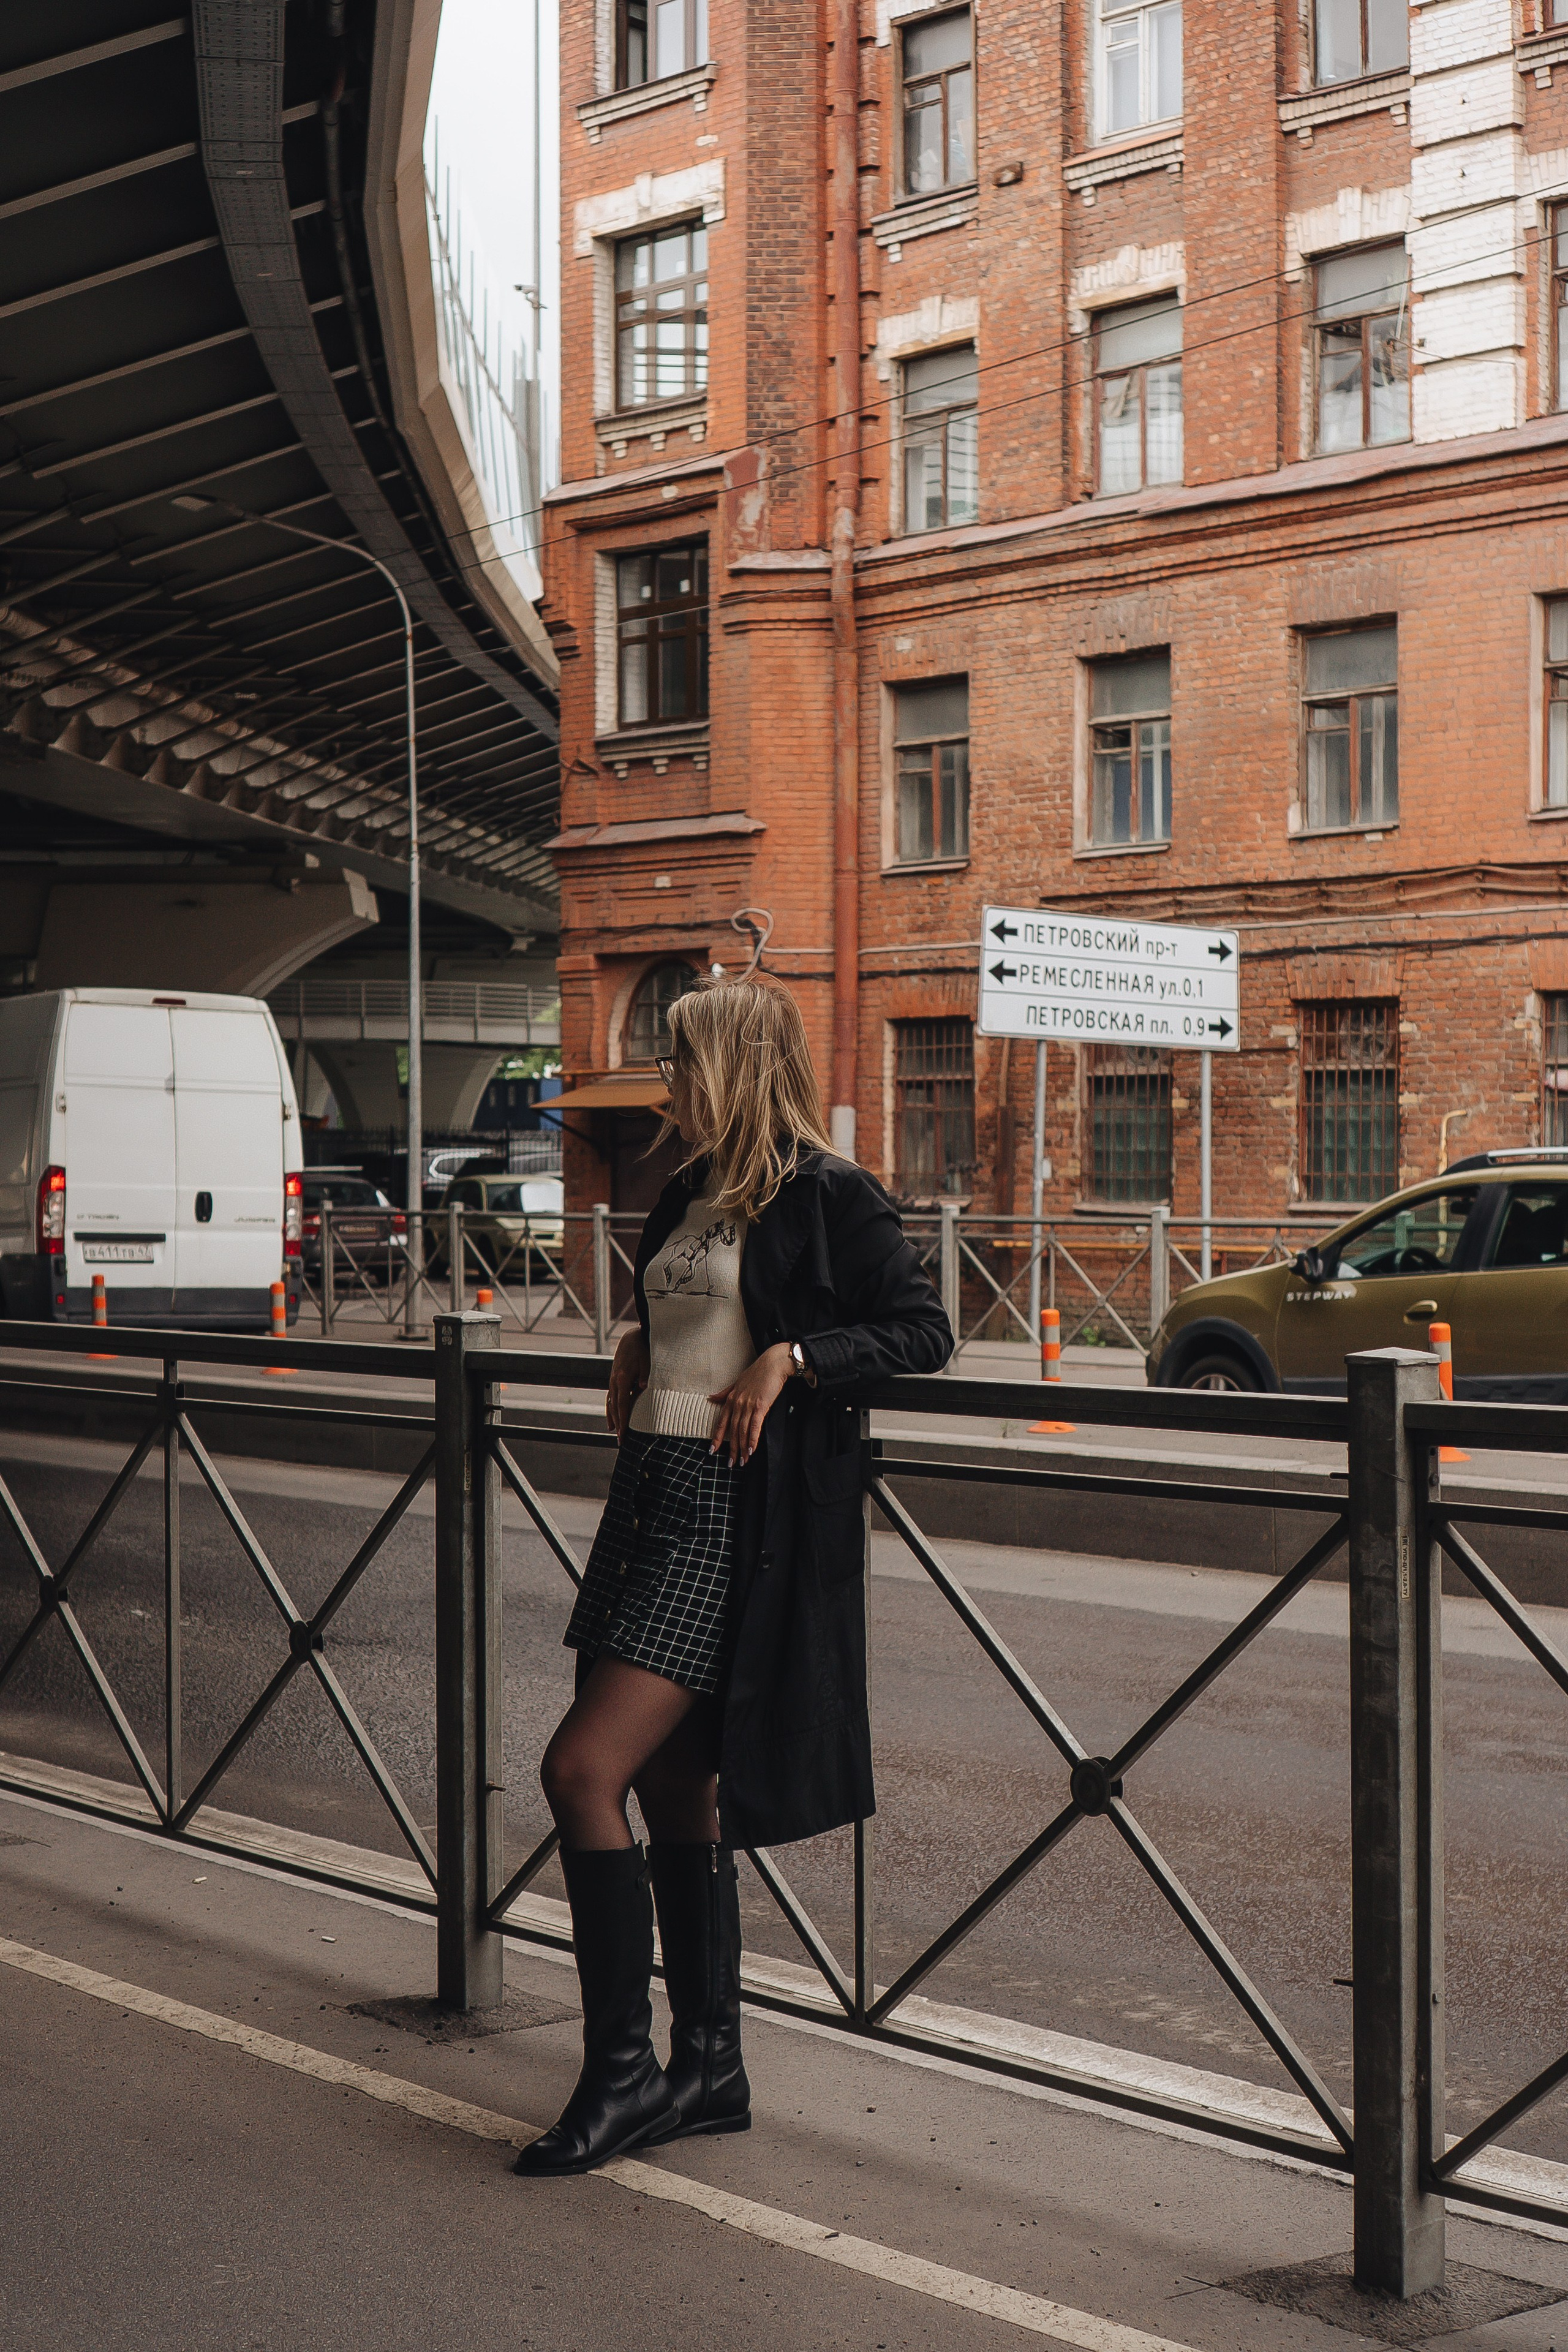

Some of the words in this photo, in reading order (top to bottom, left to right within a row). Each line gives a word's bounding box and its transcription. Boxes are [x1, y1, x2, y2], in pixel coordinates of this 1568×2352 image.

[1024, 924, 1139, 953] ПЕТРОВСКИЙ
[1146, 940, 1178, 960] пр-т
[1019, 964, 1154, 994] РЕМЕСЛЕННАЯ
[1026, 1005, 1144, 1032] ПЕТРОВСКАЯ
[1150, 1019, 1174, 1035] пл.
[1286, 1290, 1353, 1302] STEPWAY
